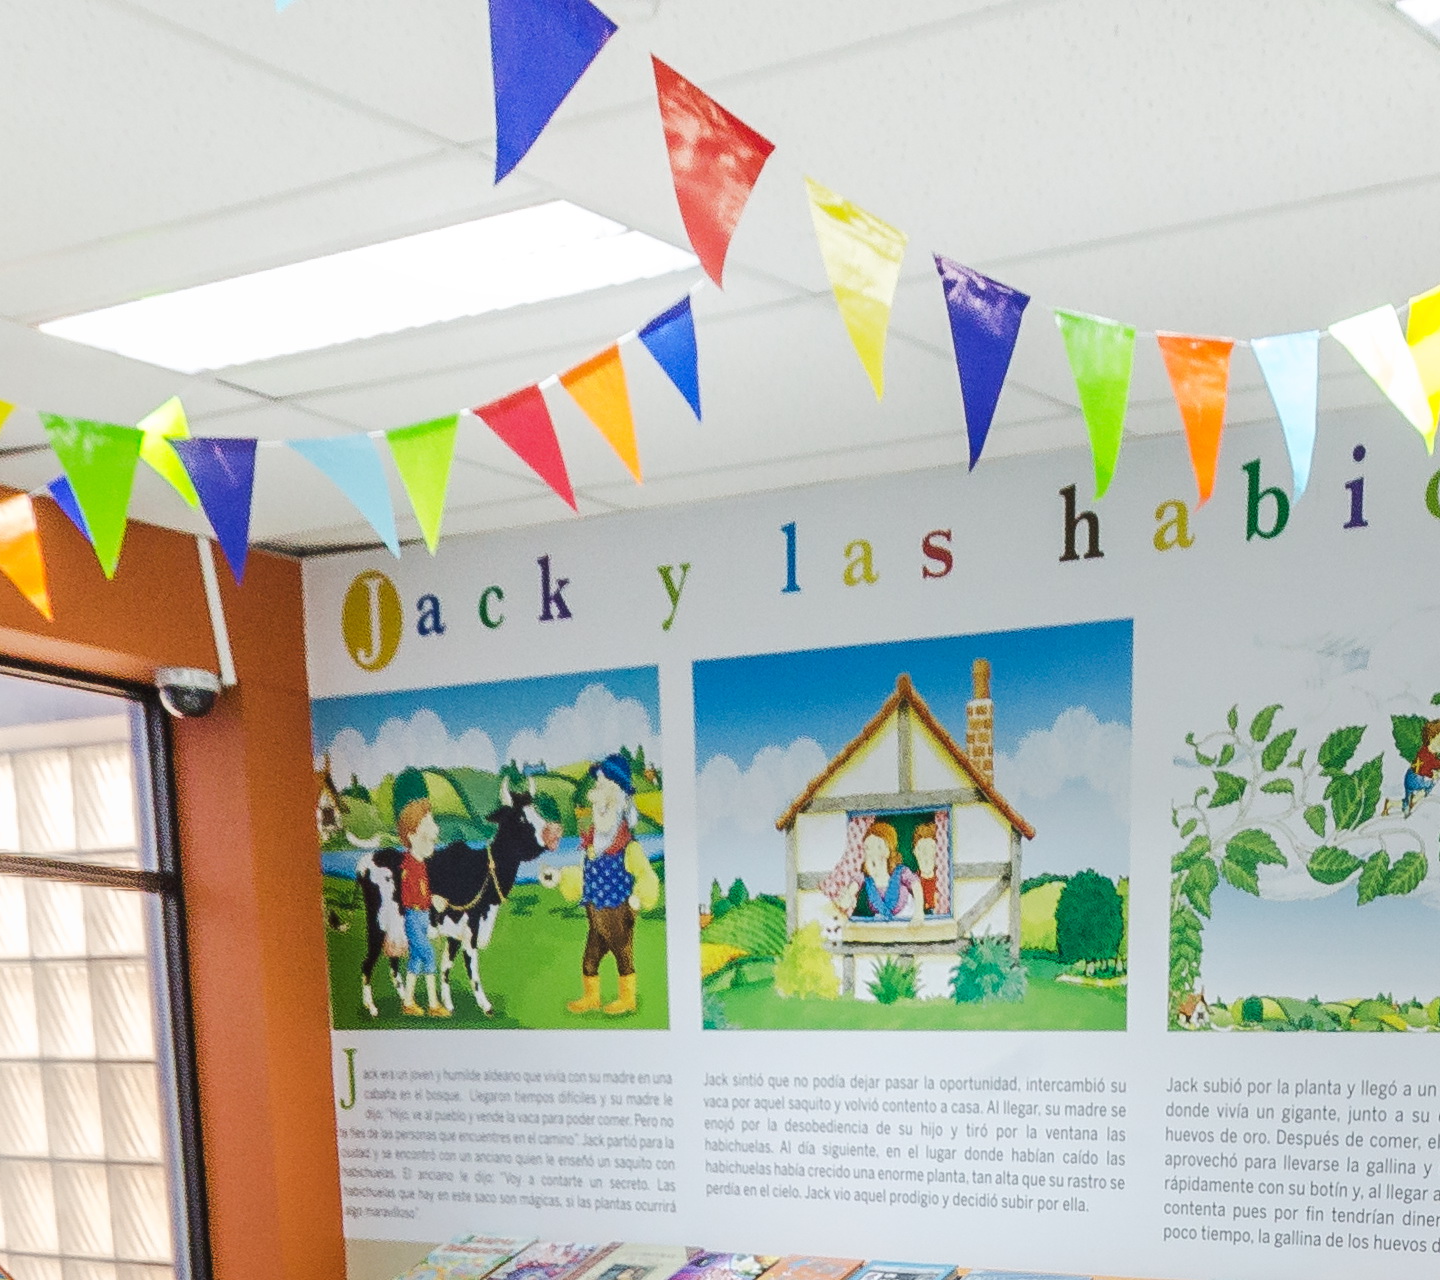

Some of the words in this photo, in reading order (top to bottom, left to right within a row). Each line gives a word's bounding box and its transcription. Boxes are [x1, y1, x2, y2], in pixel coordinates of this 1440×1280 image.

[356, 554, 573, 662] Jack
[657, 562, 691, 631] y
[780, 521, 955, 594] las
[703, 1072, 729, 1087] Jack
[732, 1073, 765, 1087] sintió
[767, 1076, 790, 1090] que
[793, 1076, 809, 1088] no
[812, 1074, 846, 1091] podía
[849, 1074, 881, 1092] dejar
[884, 1077, 919, 1092] pasar
[924, 1075, 935, 1091] la
[939, 1075, 1021, 1094] oportunidad,
[1025, 1076, 1106, 1094] intercambió
[1110, 1080, 1127, 1094] su
[1164, 1151, 1238, 1170] aprovechó
[1244, 1156, 1277, 1173] para
[1283, 1154, 1340, 1173] llevarse
[1346, 1156, 1360, 1173] la
[1365, 1157, 1416, 1178] gallina
[1422, 1162, 1433, 1180] y
